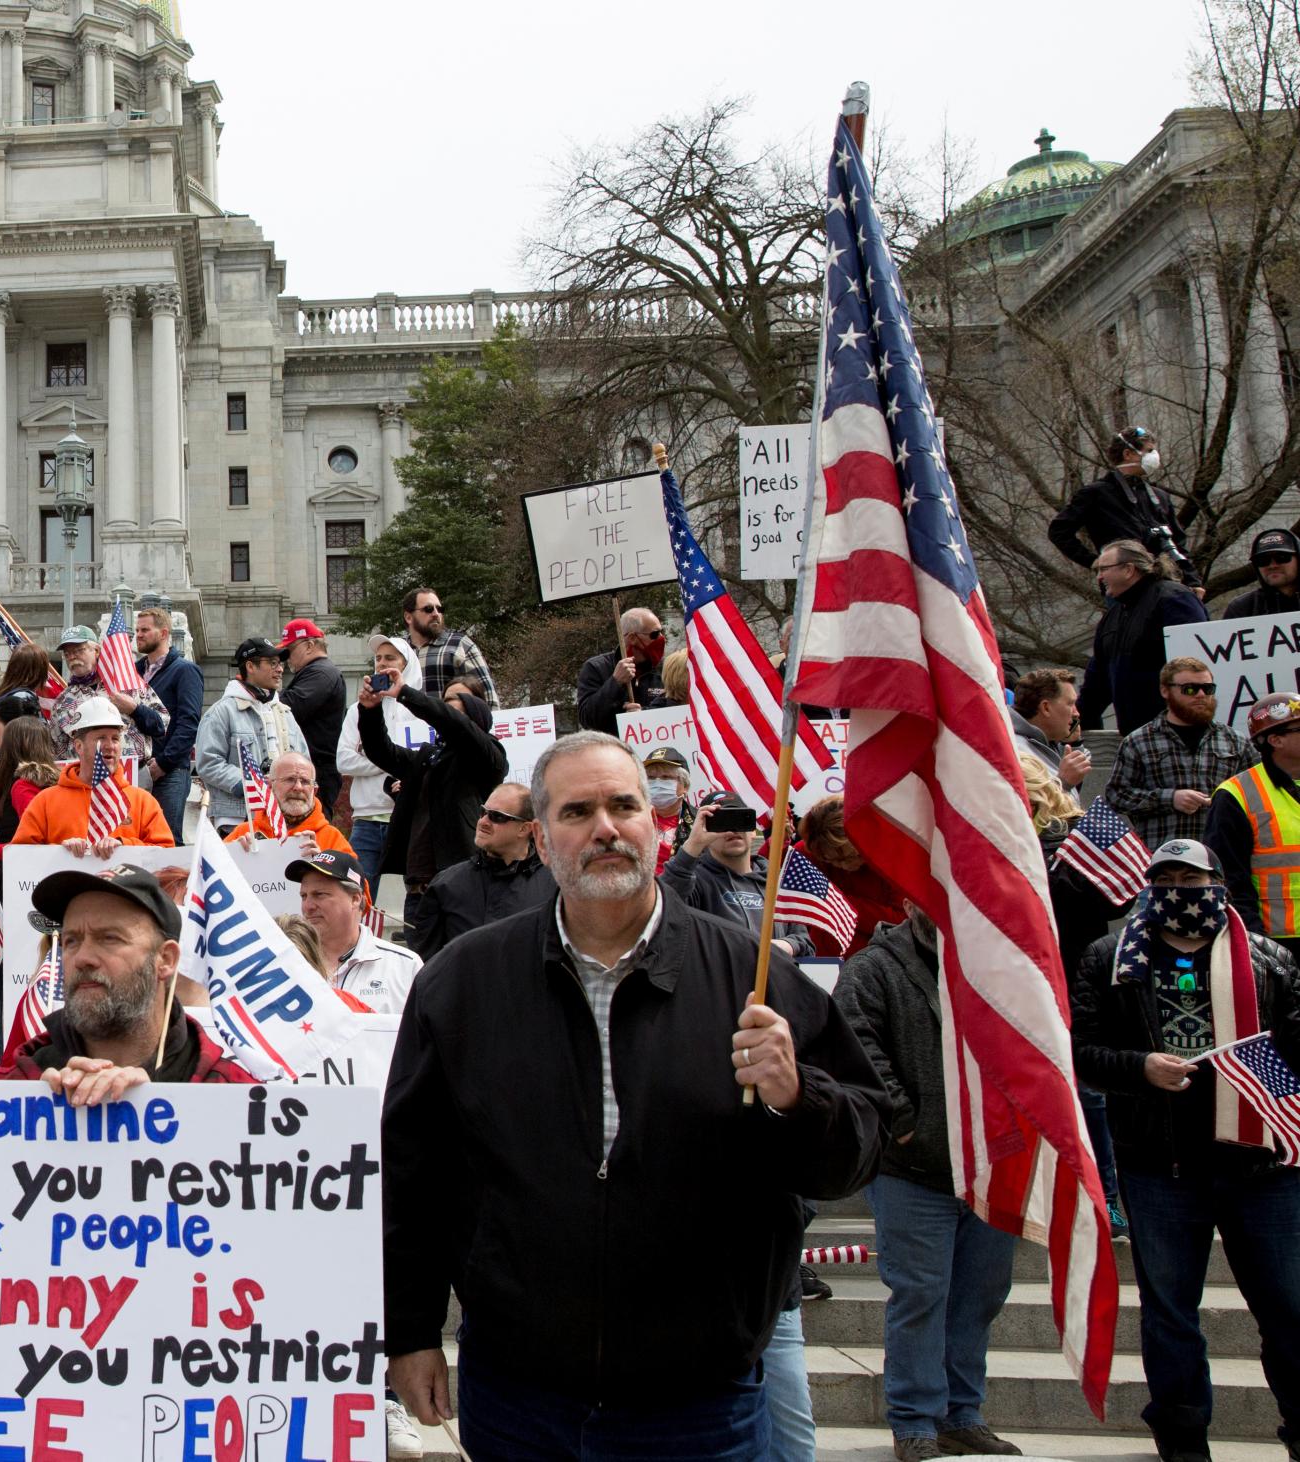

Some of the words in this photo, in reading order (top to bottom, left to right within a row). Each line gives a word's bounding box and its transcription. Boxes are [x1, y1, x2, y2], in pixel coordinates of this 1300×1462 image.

[564, 480, 632, 520] FREE
[743, 472, 798, 497] needs
[589, 520, 628, 547] THE
[774, 504, 795, 524] for
[750, 531, 782, 551] good
[547, 549, 653, 592] PEOPLE
[1194, 628, 1259, 664] WE
[248, 1085, 309, 1136] is
[12, 1160, 102, 1221] you
[131, 1142, 380, 1211] restrict
[51, 1202, 231, 1268] people.
[191, 1272, 265, 1331] is
[15, 1343, 128, 1399] you
[151, 1322, 385, 1387] restrict
[142, 1393, 376, 1462] PEOPLE
